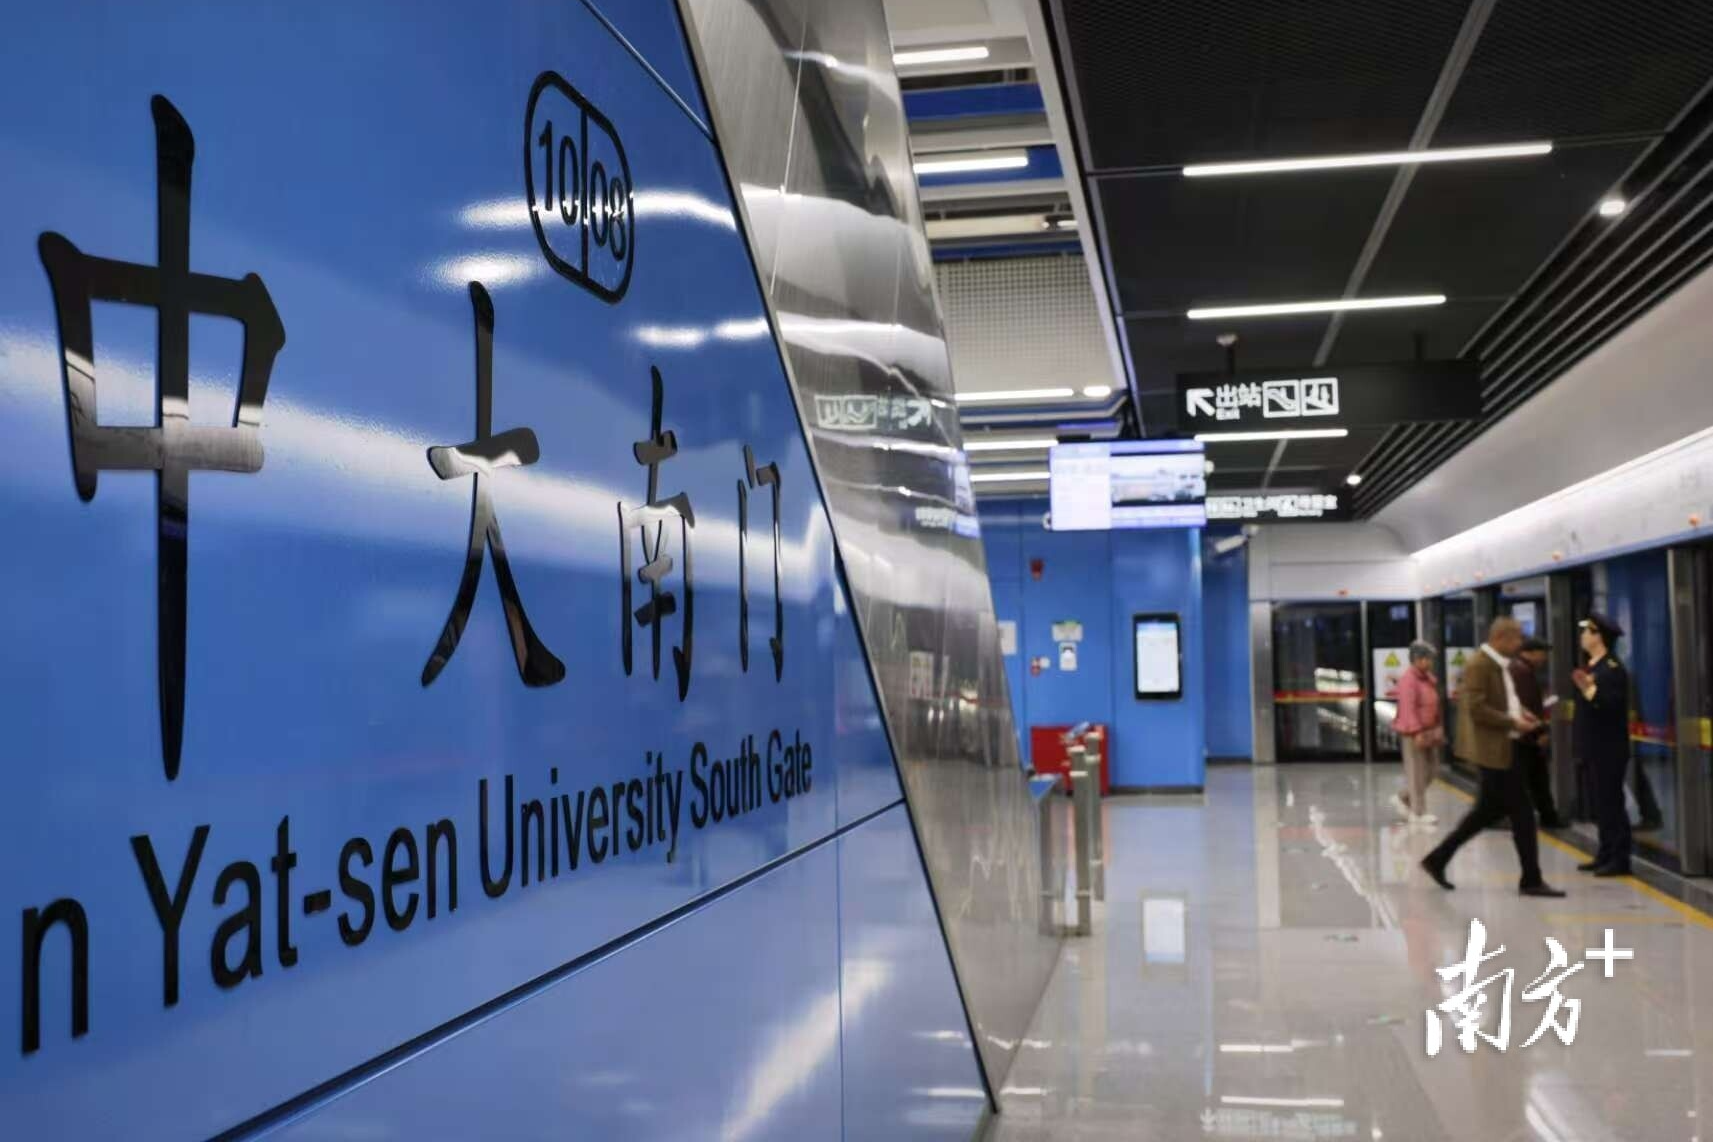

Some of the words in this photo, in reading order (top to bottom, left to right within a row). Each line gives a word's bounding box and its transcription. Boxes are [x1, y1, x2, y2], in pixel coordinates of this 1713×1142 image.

[539, 120, 579, 226] 10
[590, 161, 626, 261] 08
[37, 94, 785, 781] 中大南门
[1216, 382, 1262, 409] 出站
[131, 815, 459, 1008] Yat-sen
[479, 751, 682, 898] University
[690, 735, 762, 829] South
[767, 729, 812, 803] Gate
